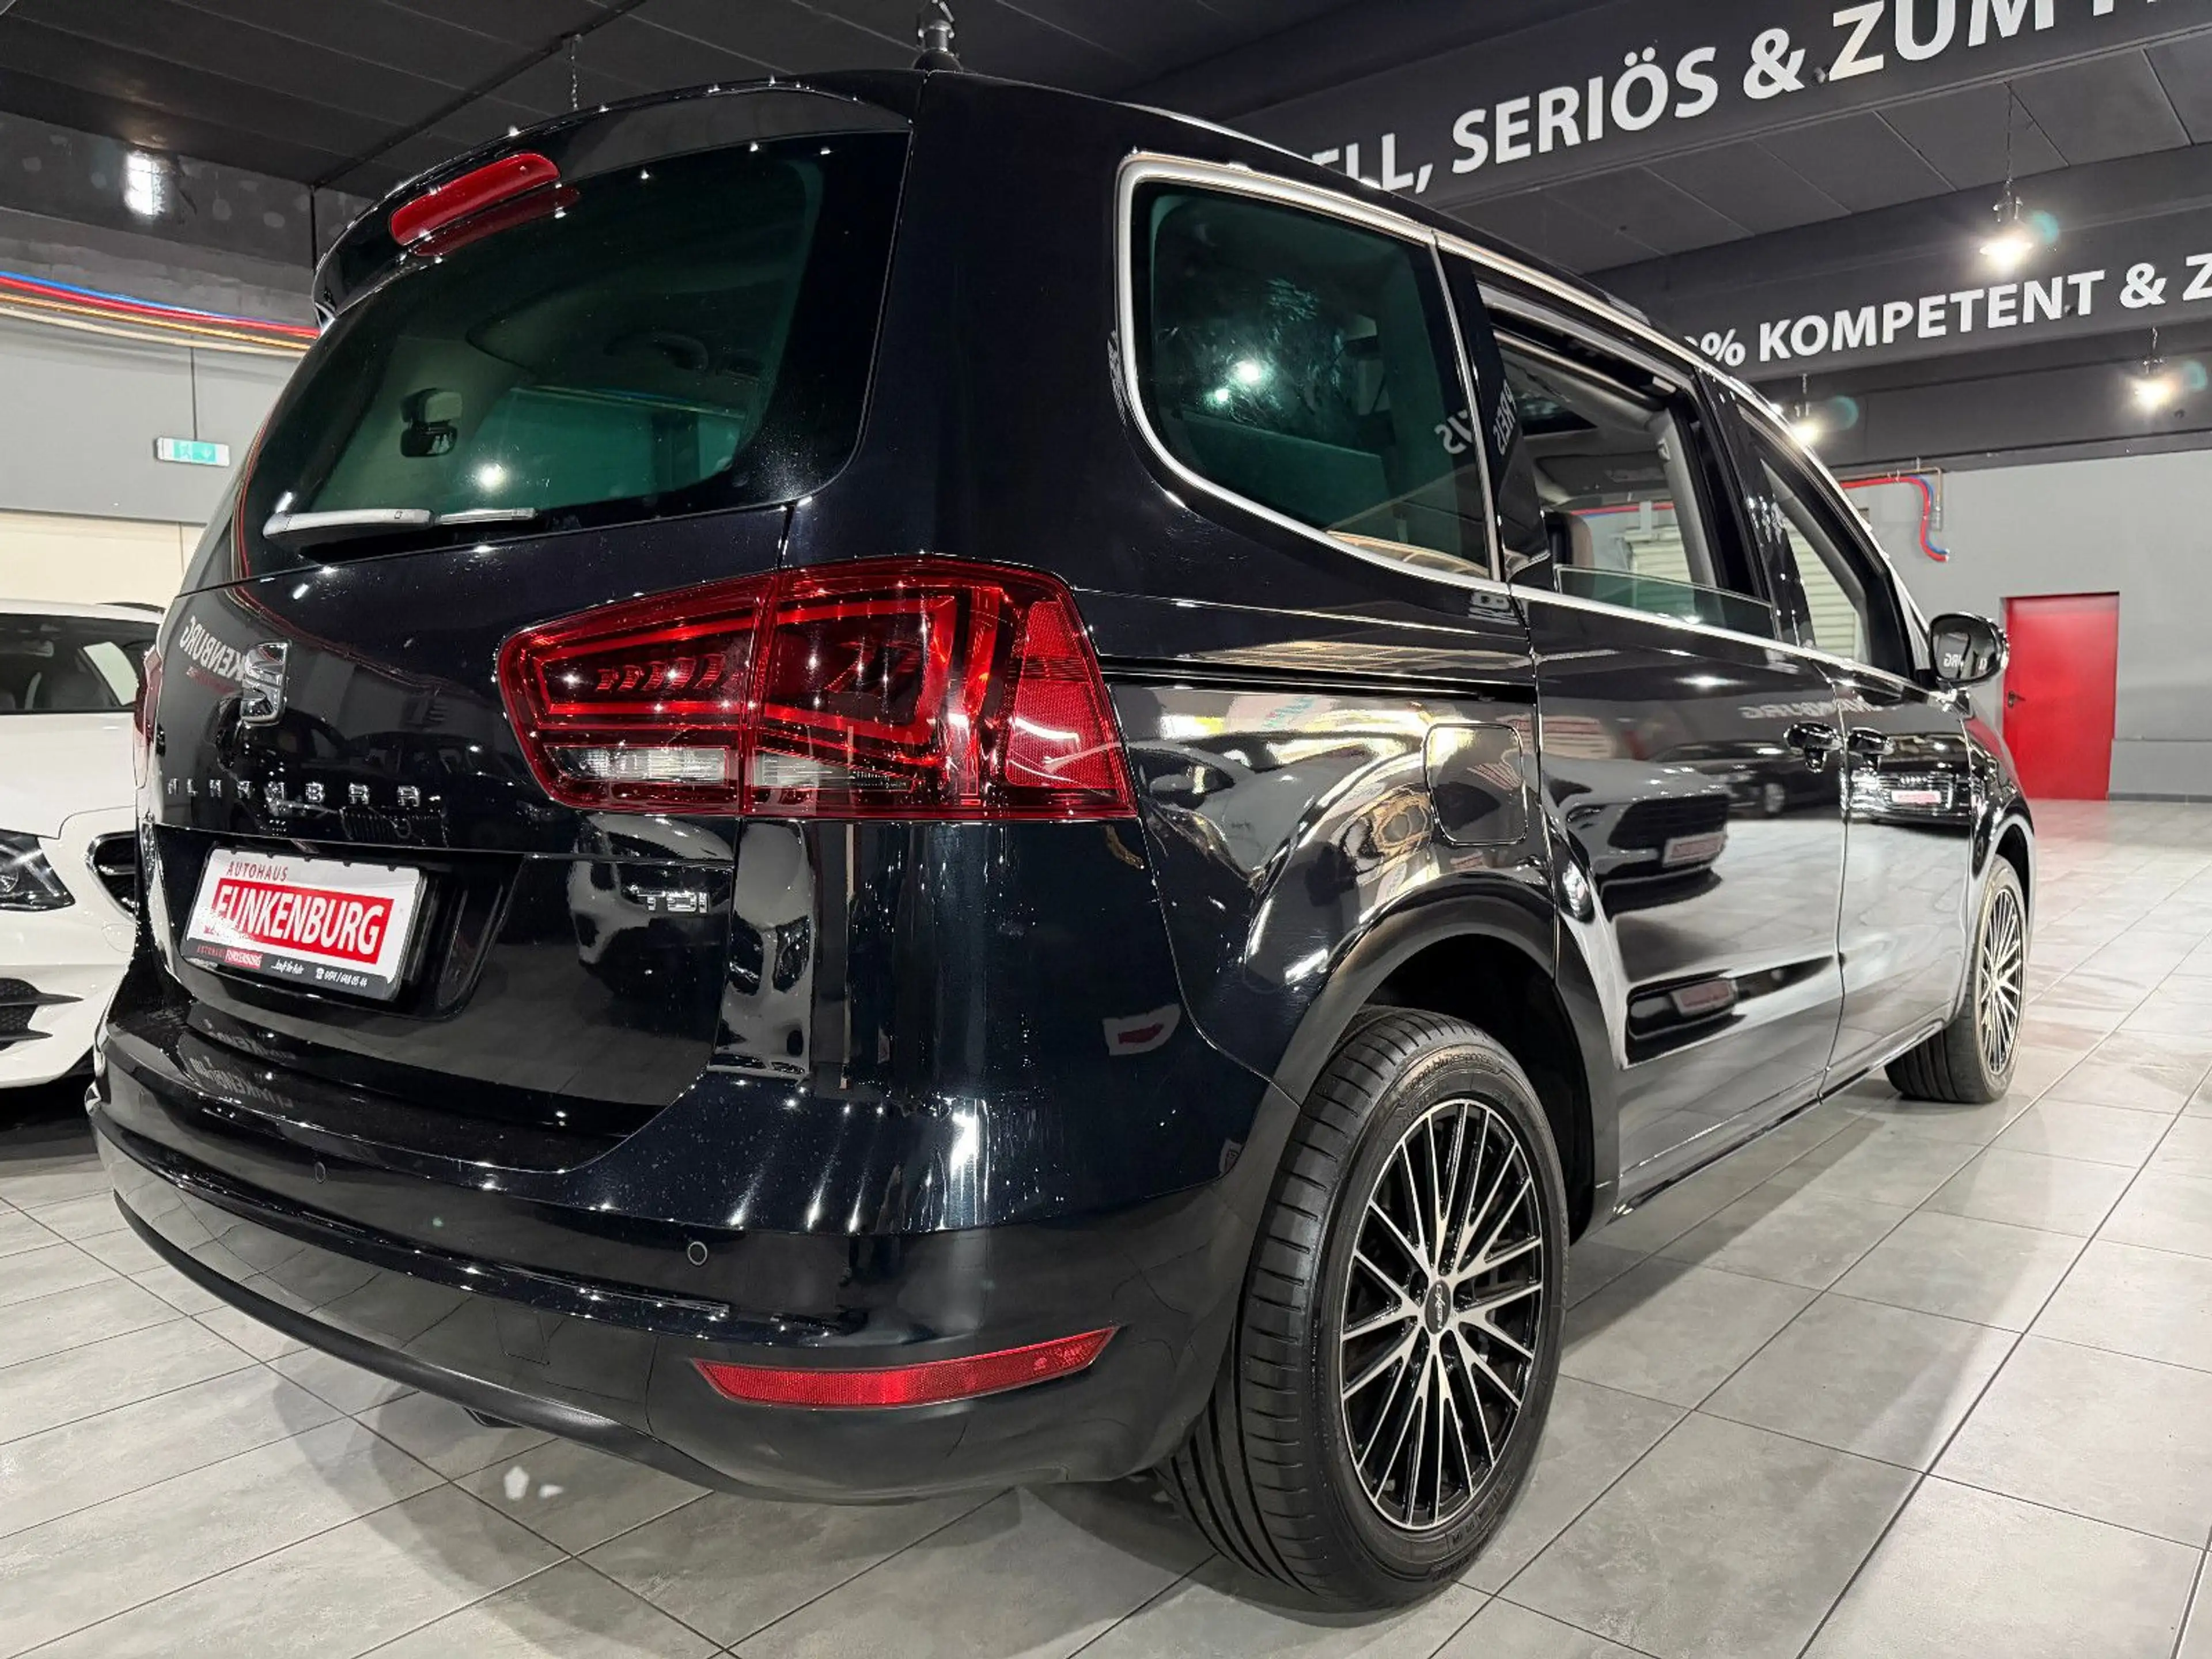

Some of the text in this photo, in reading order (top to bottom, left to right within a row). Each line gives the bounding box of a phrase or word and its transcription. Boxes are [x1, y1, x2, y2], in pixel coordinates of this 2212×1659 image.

[1452, 47, 1718, 173] SERIÖS
[1743, 28, 1806, 100] &
[1828, 0, 2054, 81] ZUM
[1759, 269, 2105, 362] KOMPETENT
[2119, 263, 2166, 308] &
[168, 778, 420, 806] ALHAMBRA
[226, 861, 288, 882] AUTOHAUS
[213, 884, 385, 955] FUNKENBURG
